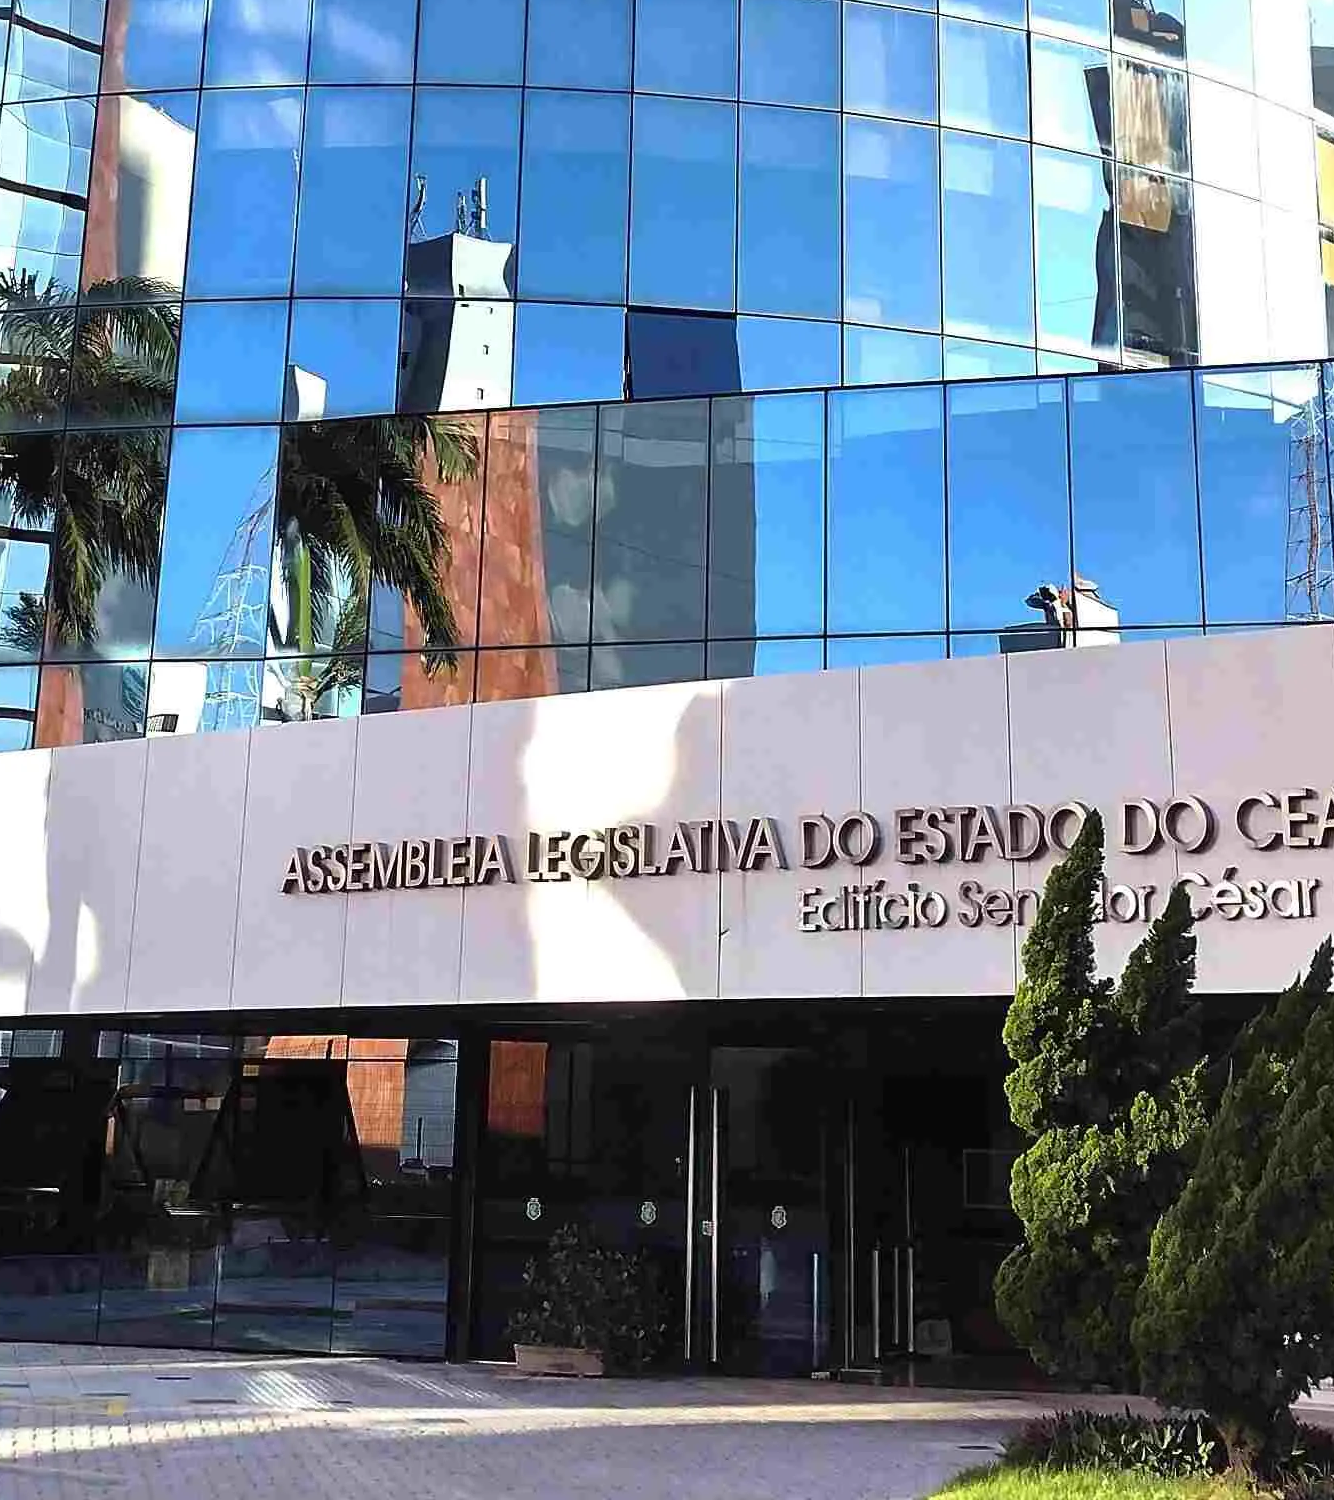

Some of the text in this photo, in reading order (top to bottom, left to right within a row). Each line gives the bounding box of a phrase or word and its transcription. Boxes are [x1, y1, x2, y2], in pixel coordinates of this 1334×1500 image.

[281, 833, 516, 894] ASSEMBLEIA
[524, 815, 788, 882] LEGISLATIVA
[798, 810, 881, 870] DO
[895, 801, 1090, 864] ESTADO
[1121, 795, 1219, 854] DO
[797, 880, 948, 932] Edifício
[958, 878, 1156, 927] Senor
